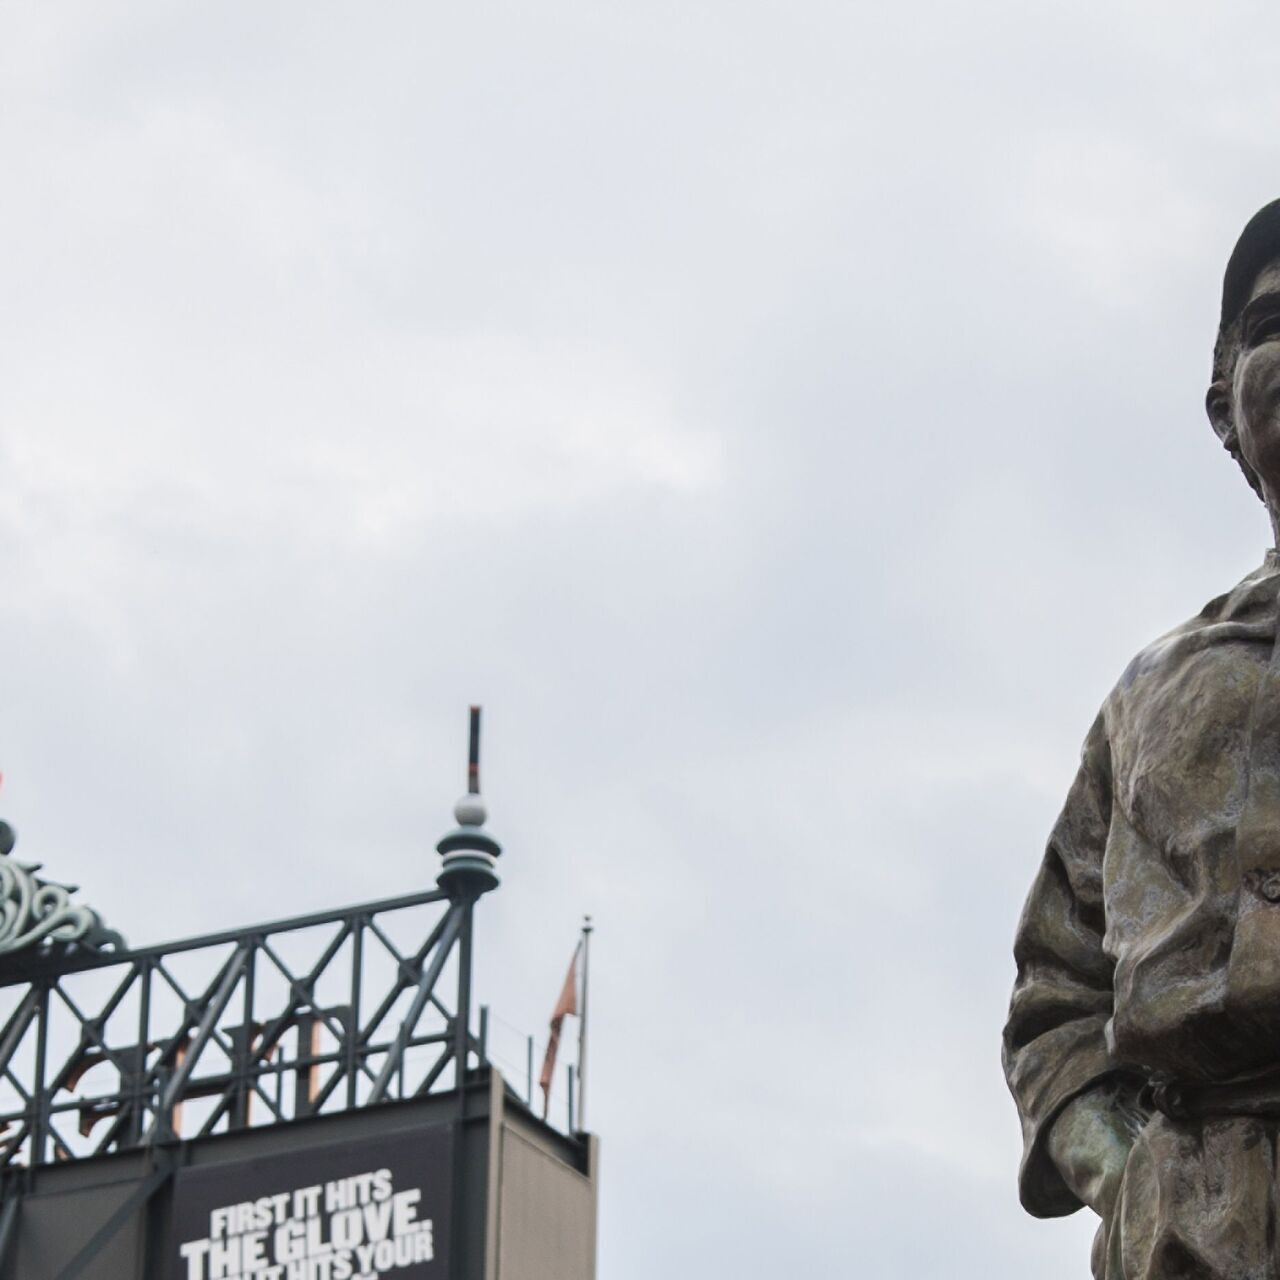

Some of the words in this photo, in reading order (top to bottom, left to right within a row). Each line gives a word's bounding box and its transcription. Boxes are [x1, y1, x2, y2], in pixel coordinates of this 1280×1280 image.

[210, 1193, 290, 1240] FIRST
[293, 1185, 323, 1220] IT
[326, 1168, 392, 1213] HITS
[274, 1188, 433, 1265] GLOVE.
[356, 1231, 433, 1275] YOUR
